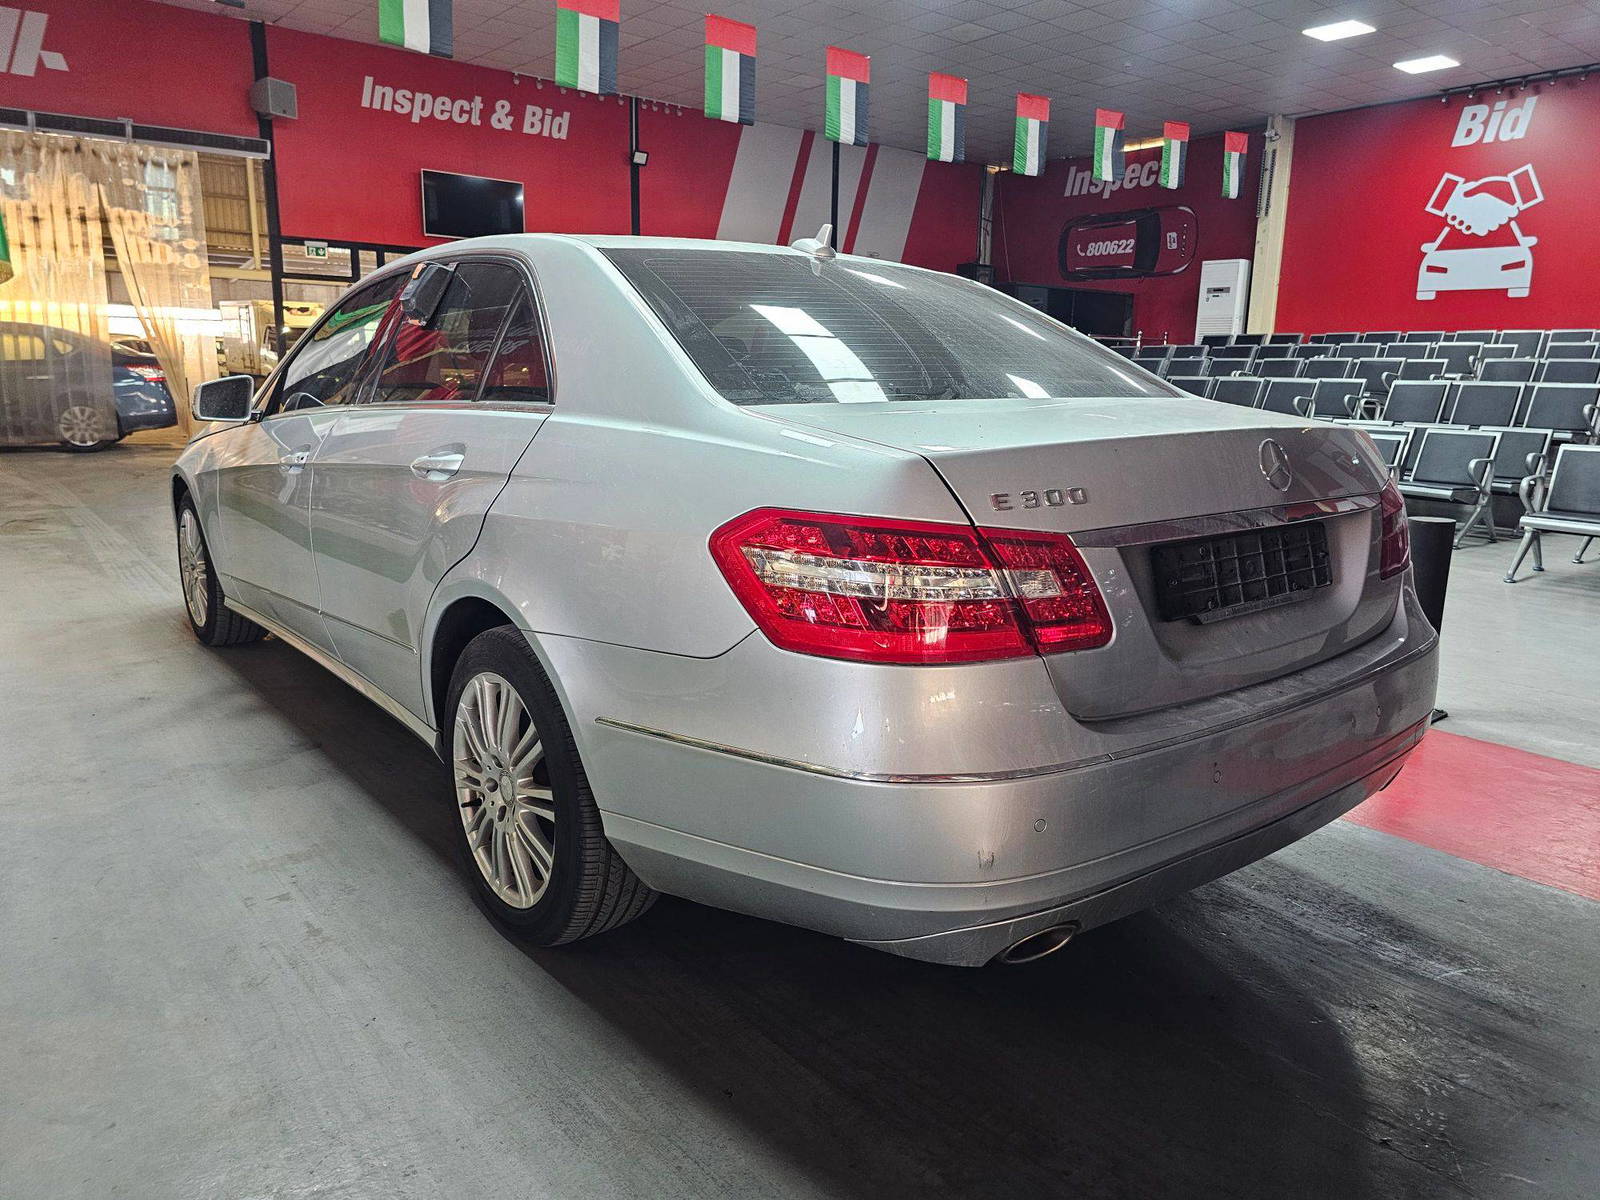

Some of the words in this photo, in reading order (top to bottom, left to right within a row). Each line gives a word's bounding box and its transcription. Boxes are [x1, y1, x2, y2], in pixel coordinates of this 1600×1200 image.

[361, 75, 483, 126] Inspect
[490, 100, 513, 131] &
[522, 104, 571, 140] Bid
[1451, 95, 1538, 148] Bid
[1064, 160, 1164, 199] Inspec
[1086, 239, 1136, 257] 800622
[991, 493, 1014, 511] E
[1020, 487, 1088, 509] 300
